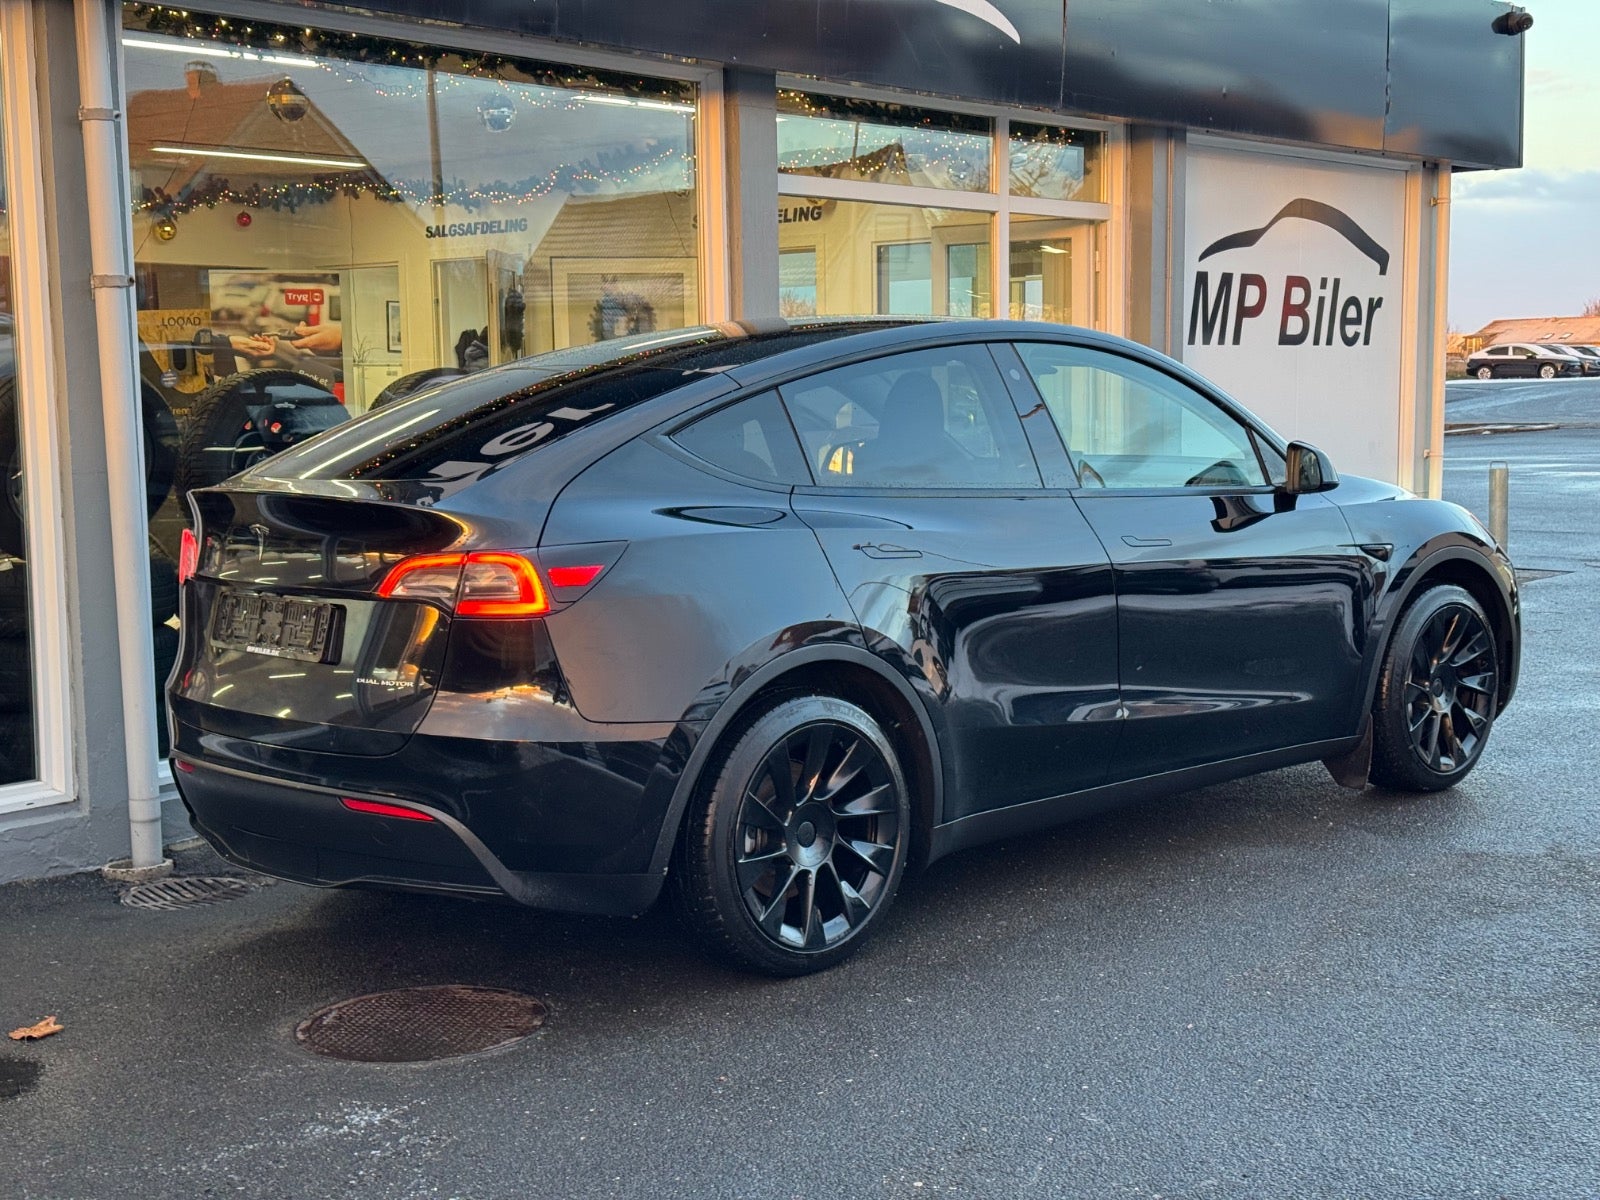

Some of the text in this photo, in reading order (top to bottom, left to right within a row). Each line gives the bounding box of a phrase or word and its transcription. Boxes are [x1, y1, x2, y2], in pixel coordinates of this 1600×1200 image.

[425, 218, 528, 239] SALGSAFDELING
[286, 292, 308, 303] Tryg
[1187, 270, 1384, 347] MP Biler
[356, 677, 414, 688] DUAL MOTOR
